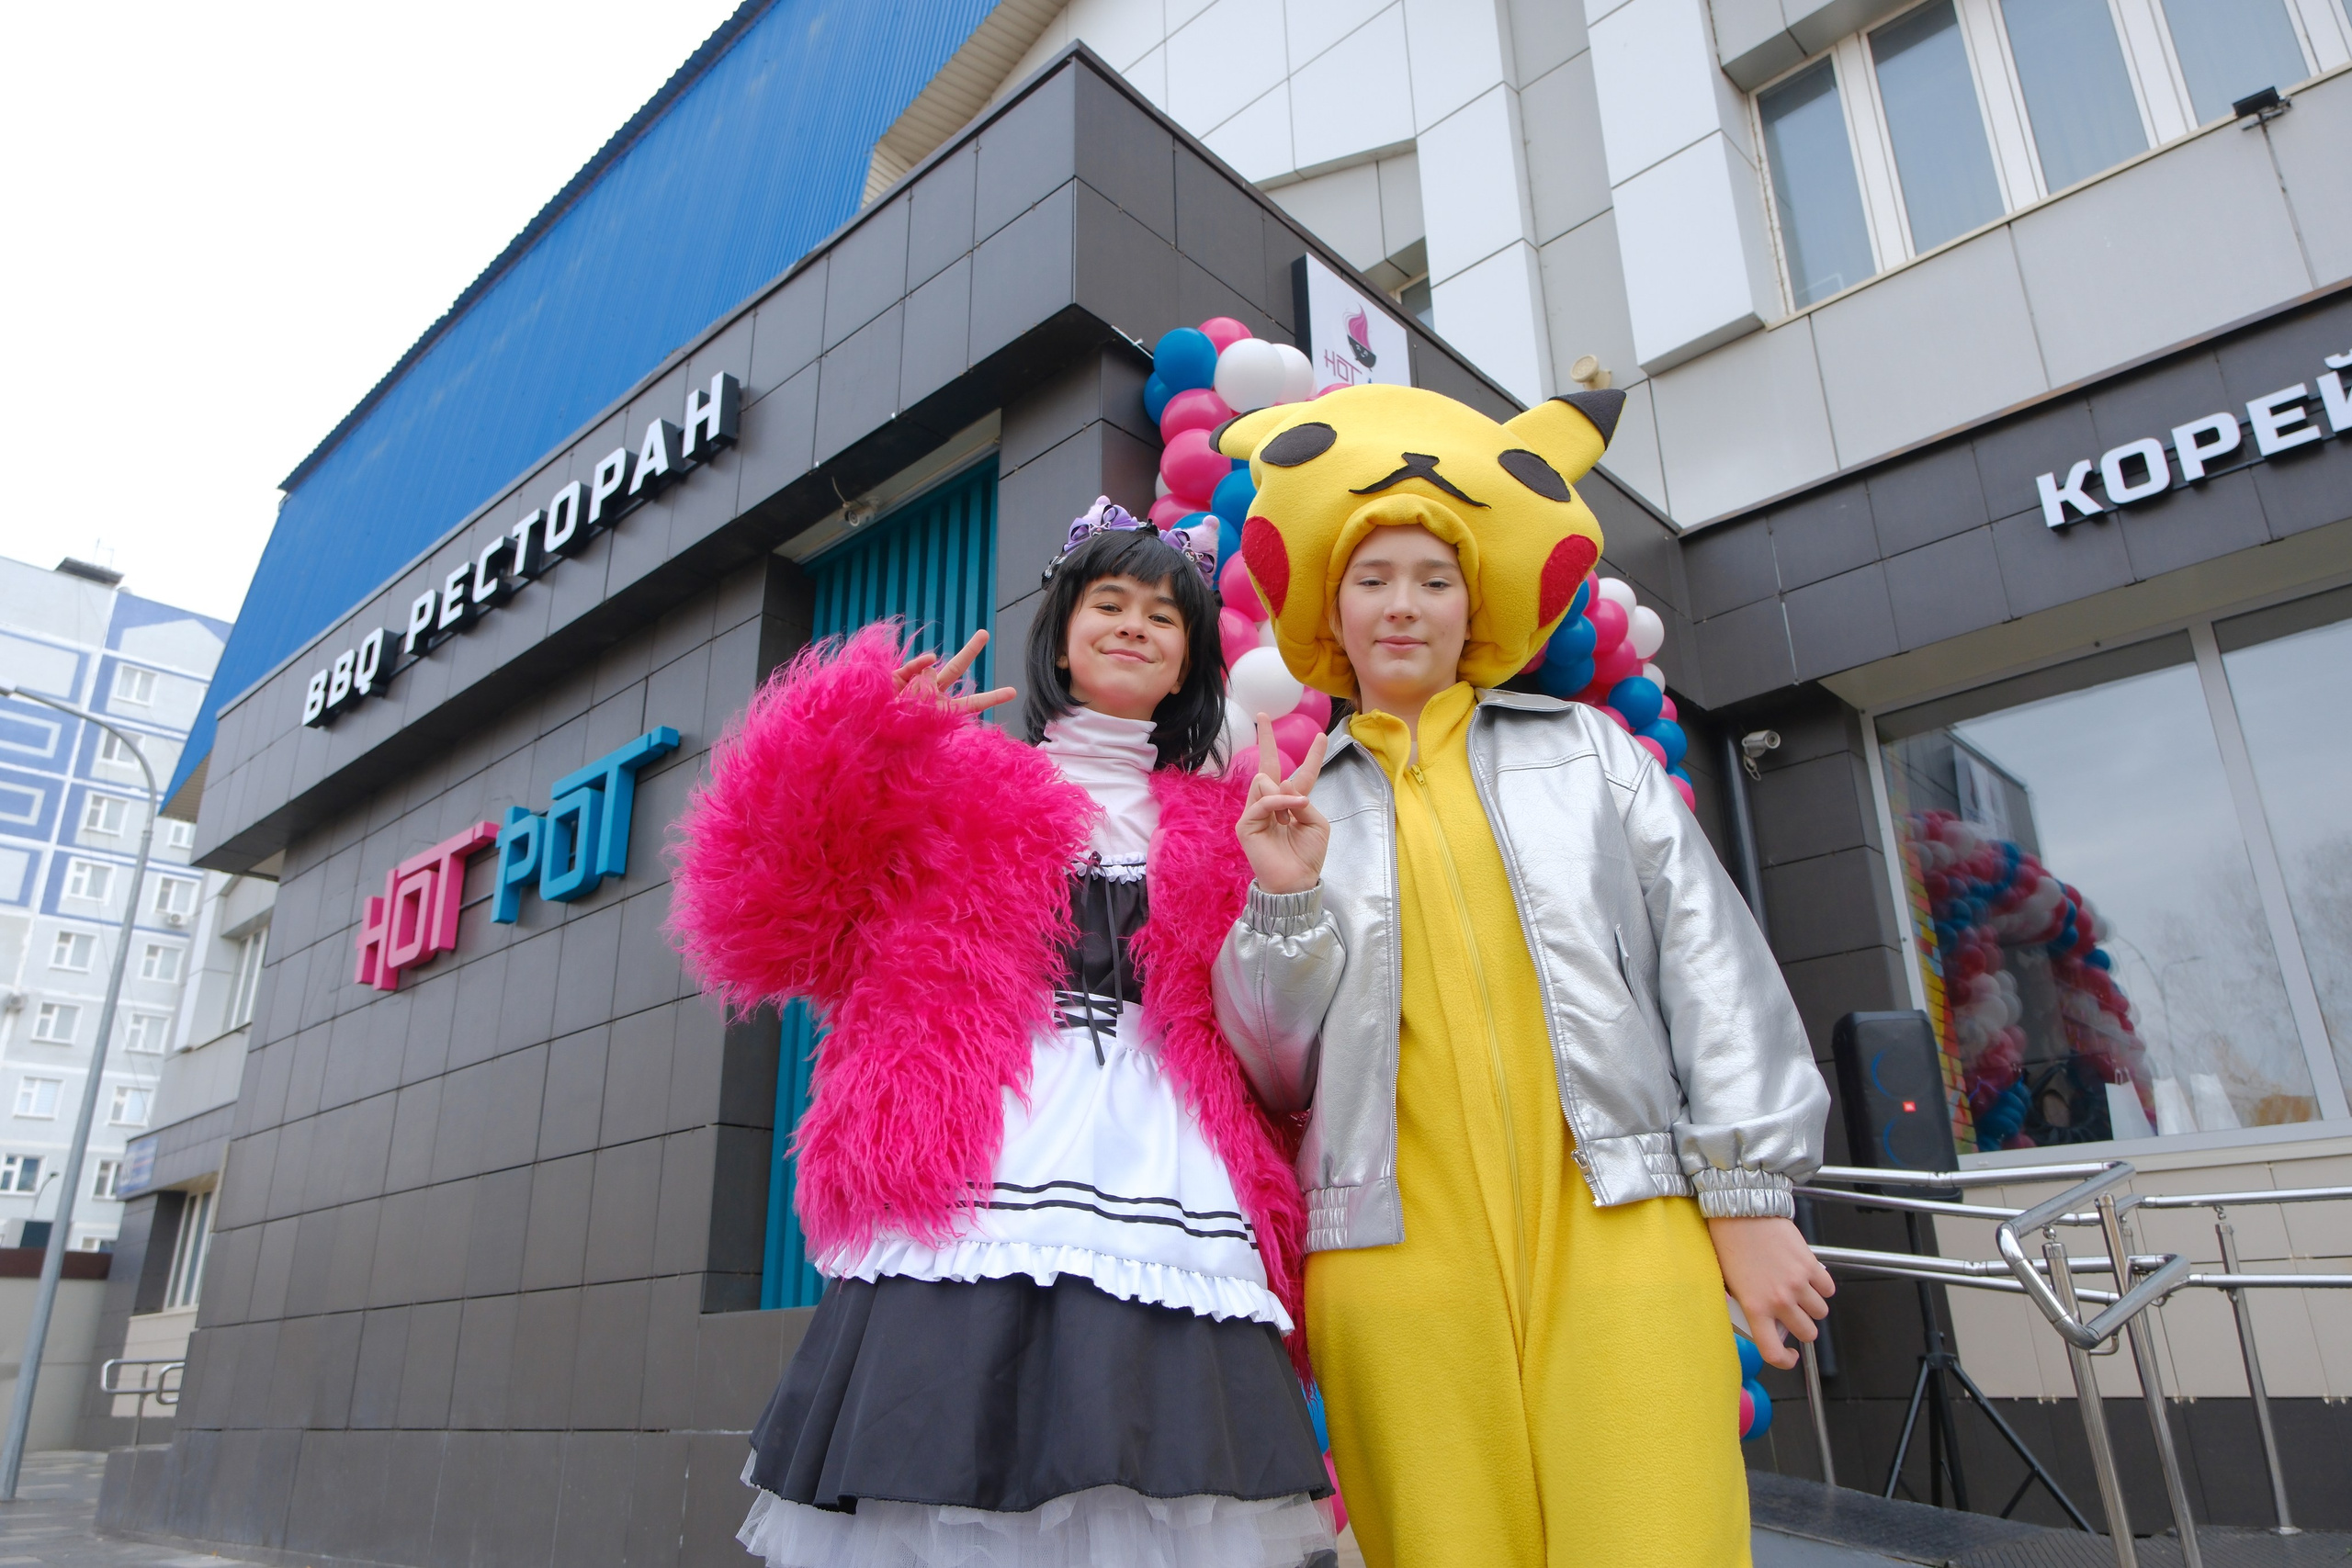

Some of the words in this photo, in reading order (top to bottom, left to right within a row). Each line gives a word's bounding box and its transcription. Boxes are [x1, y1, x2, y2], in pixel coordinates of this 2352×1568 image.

[1324, 349, 1363, 386] HOT
[301, 626, 386, 727] BBQ
[404, 370, 728, 655] РЕСТОРАН
[354, 821, 500, 990] HOT
[490, 725, 680, 924] POT
